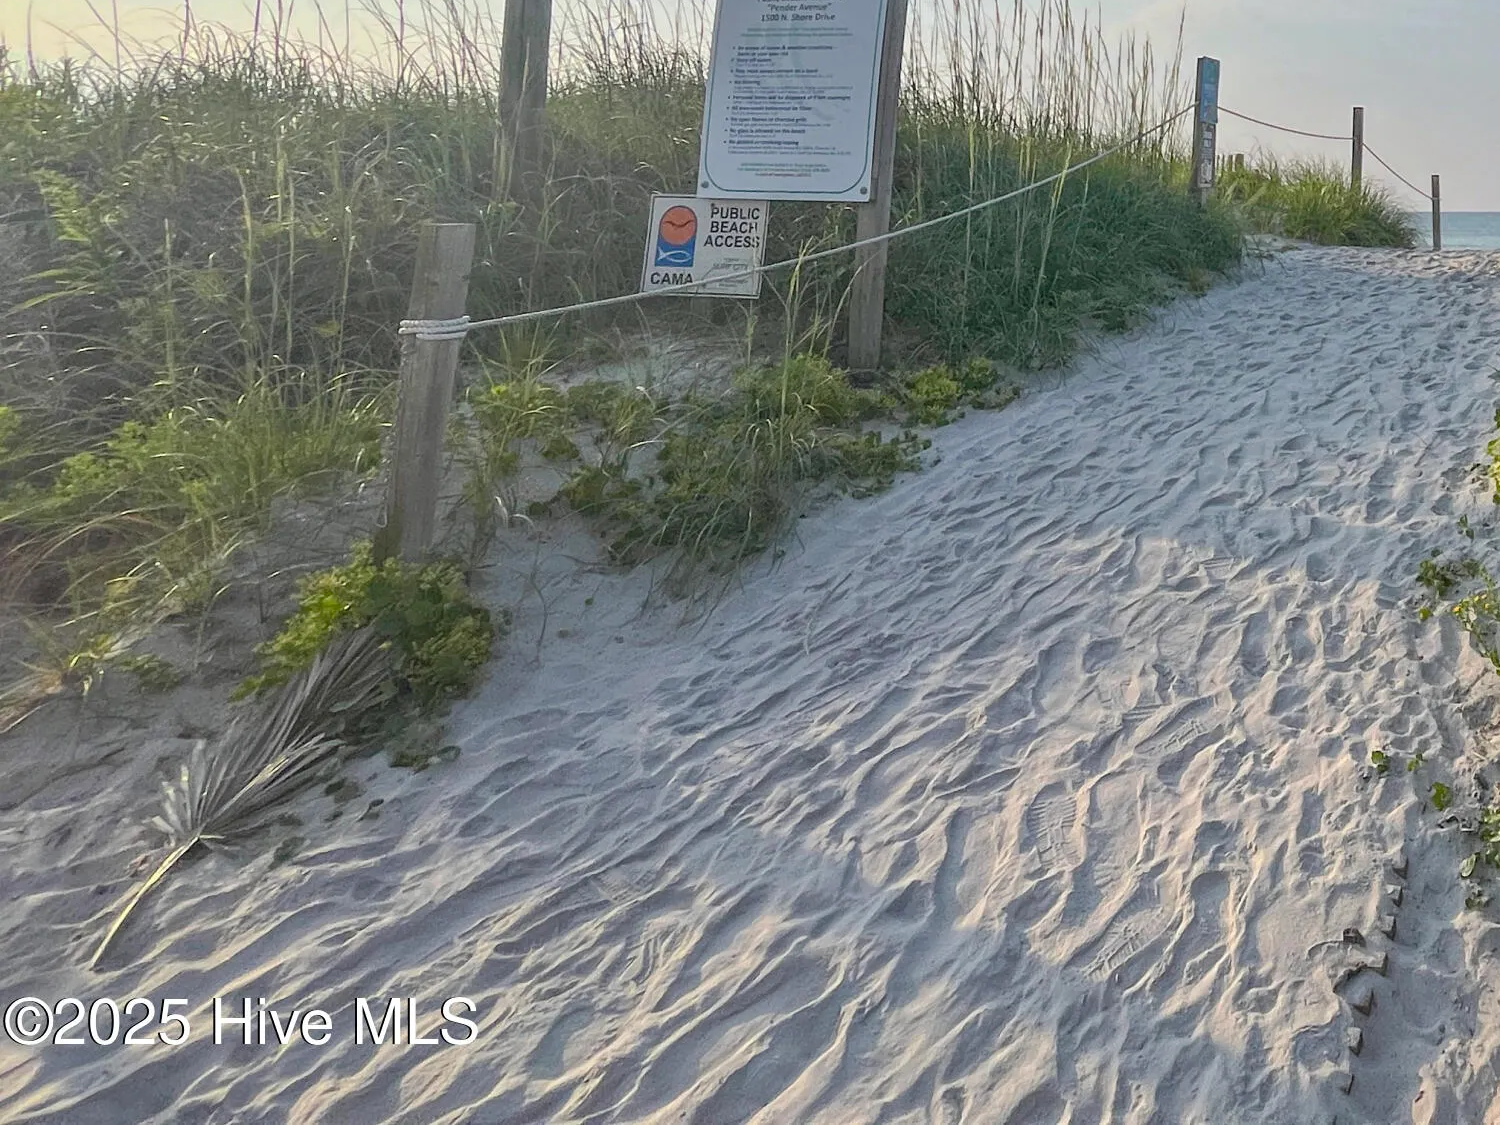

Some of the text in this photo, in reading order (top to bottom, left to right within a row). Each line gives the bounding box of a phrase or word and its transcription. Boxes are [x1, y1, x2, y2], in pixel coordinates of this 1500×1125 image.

[761, 14, 780, 22] 1500
[791, 13, 813, 21] Shore
[815, 13, 836, 21] Drive
[710, 207, 760, 220] PUBLIC
[709, 220, 758, 234] BEACH
[703, 235, 760, 248] ACCESS
[650, 272, 693, 285] CAMA
